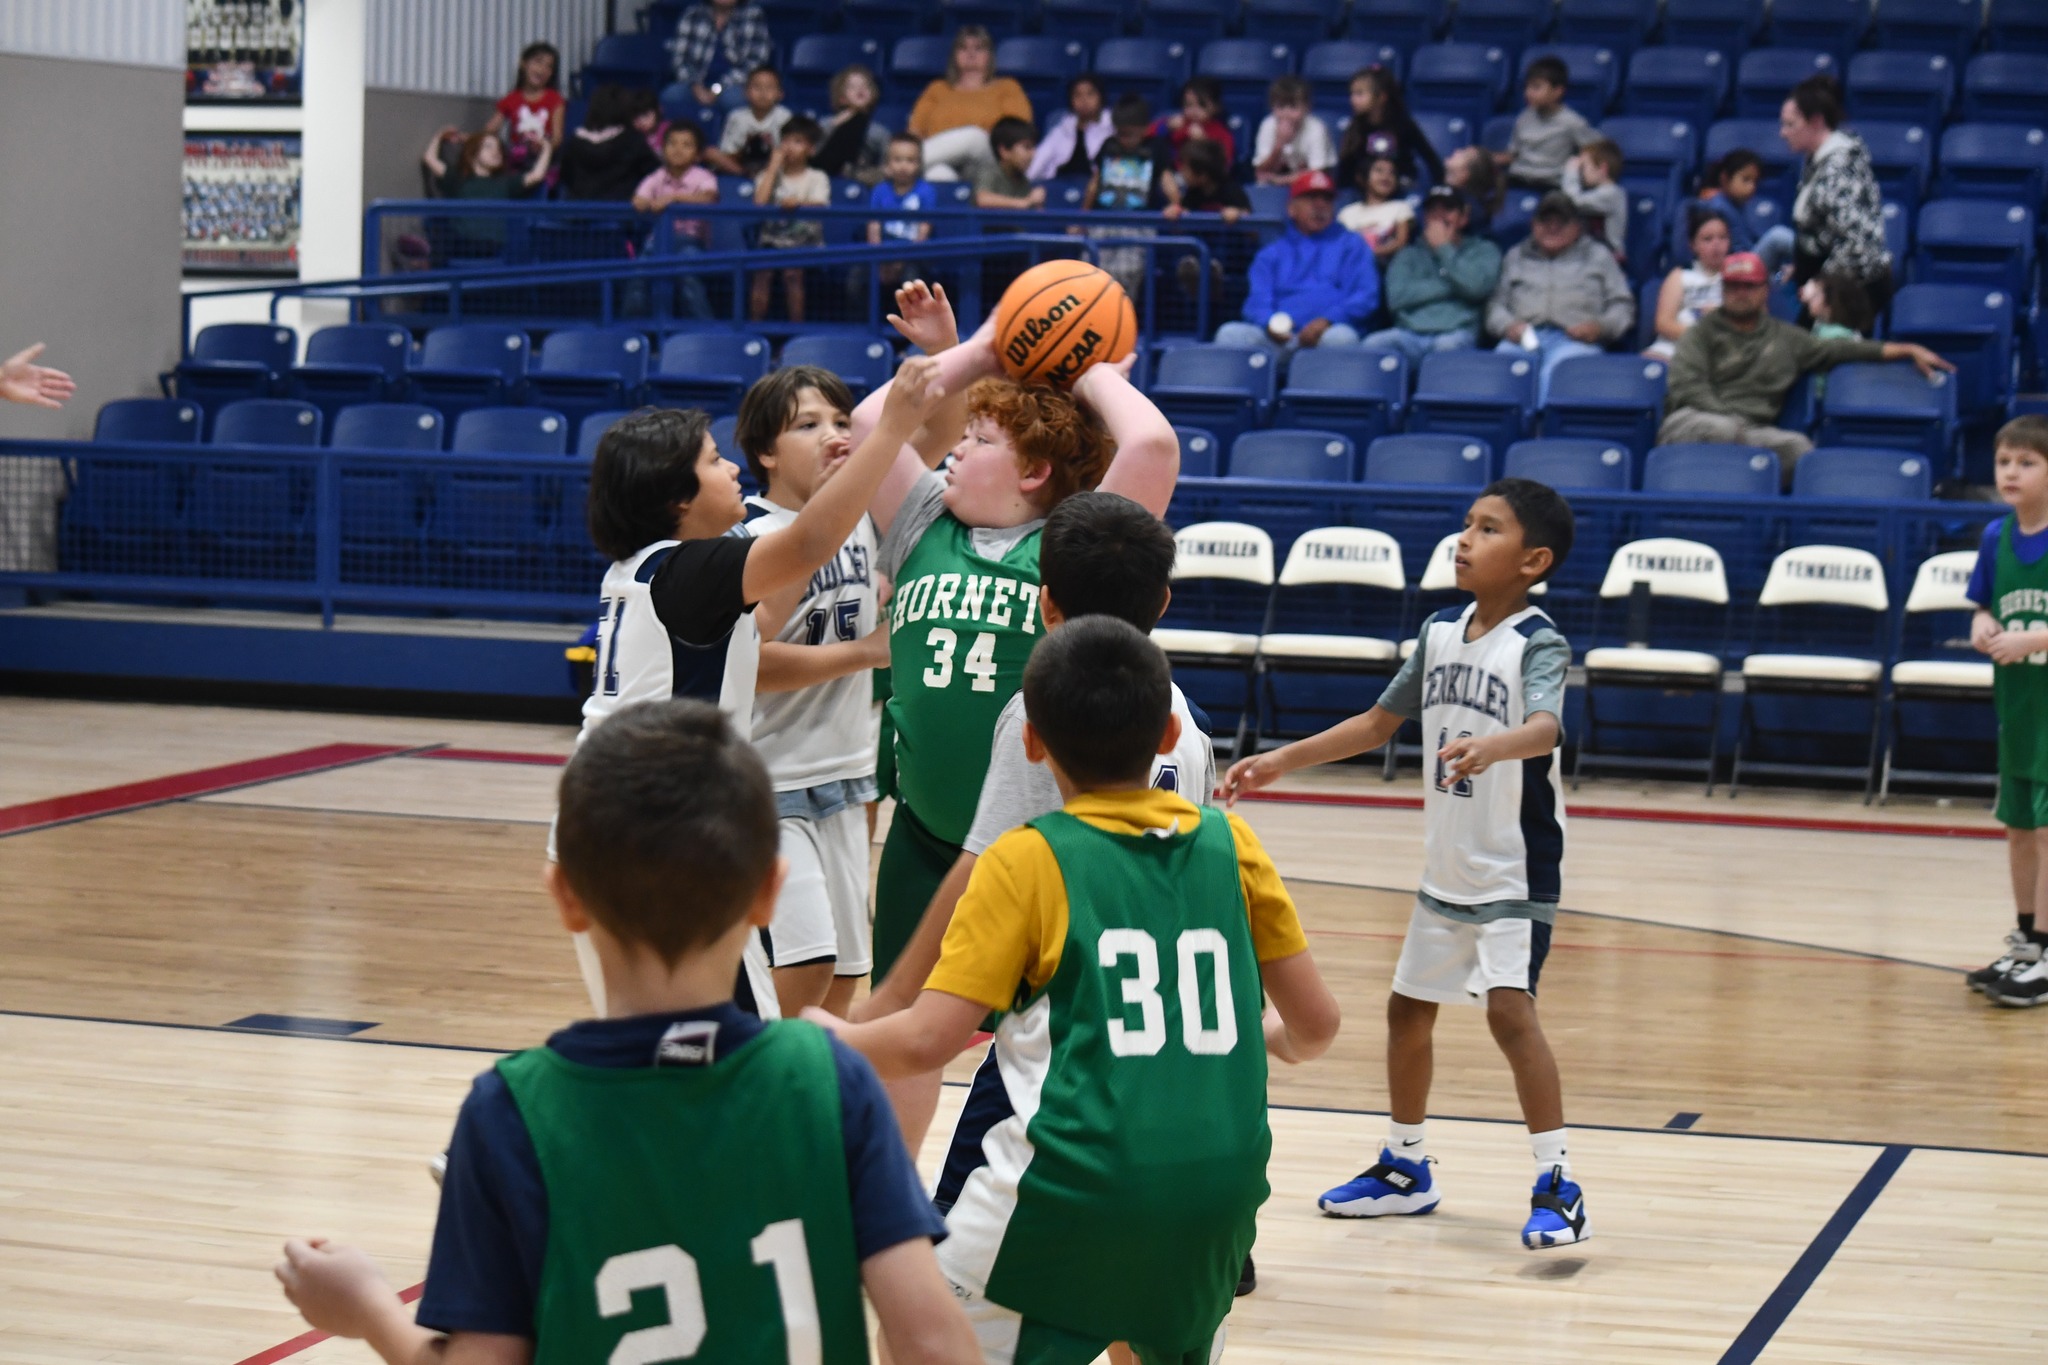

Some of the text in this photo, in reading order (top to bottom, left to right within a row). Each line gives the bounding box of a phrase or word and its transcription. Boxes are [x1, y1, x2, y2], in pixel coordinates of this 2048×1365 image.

[1006, 294, 1081, 367] Wilson
[1045, 328, 1103, 386] NCAA
[1305, 542, 1390, 561] TENKILLER
[1627, 552, 1713, 573] TENKILLER
[1786, 560, 1873, 582] TENKILLER
[922, 627, 998, 692] 34
[1098, 928, 1238, 1058] 30
[1385, 1171, 1412, 1188] NIKE
[595, 1217, 823, 1365] 21
